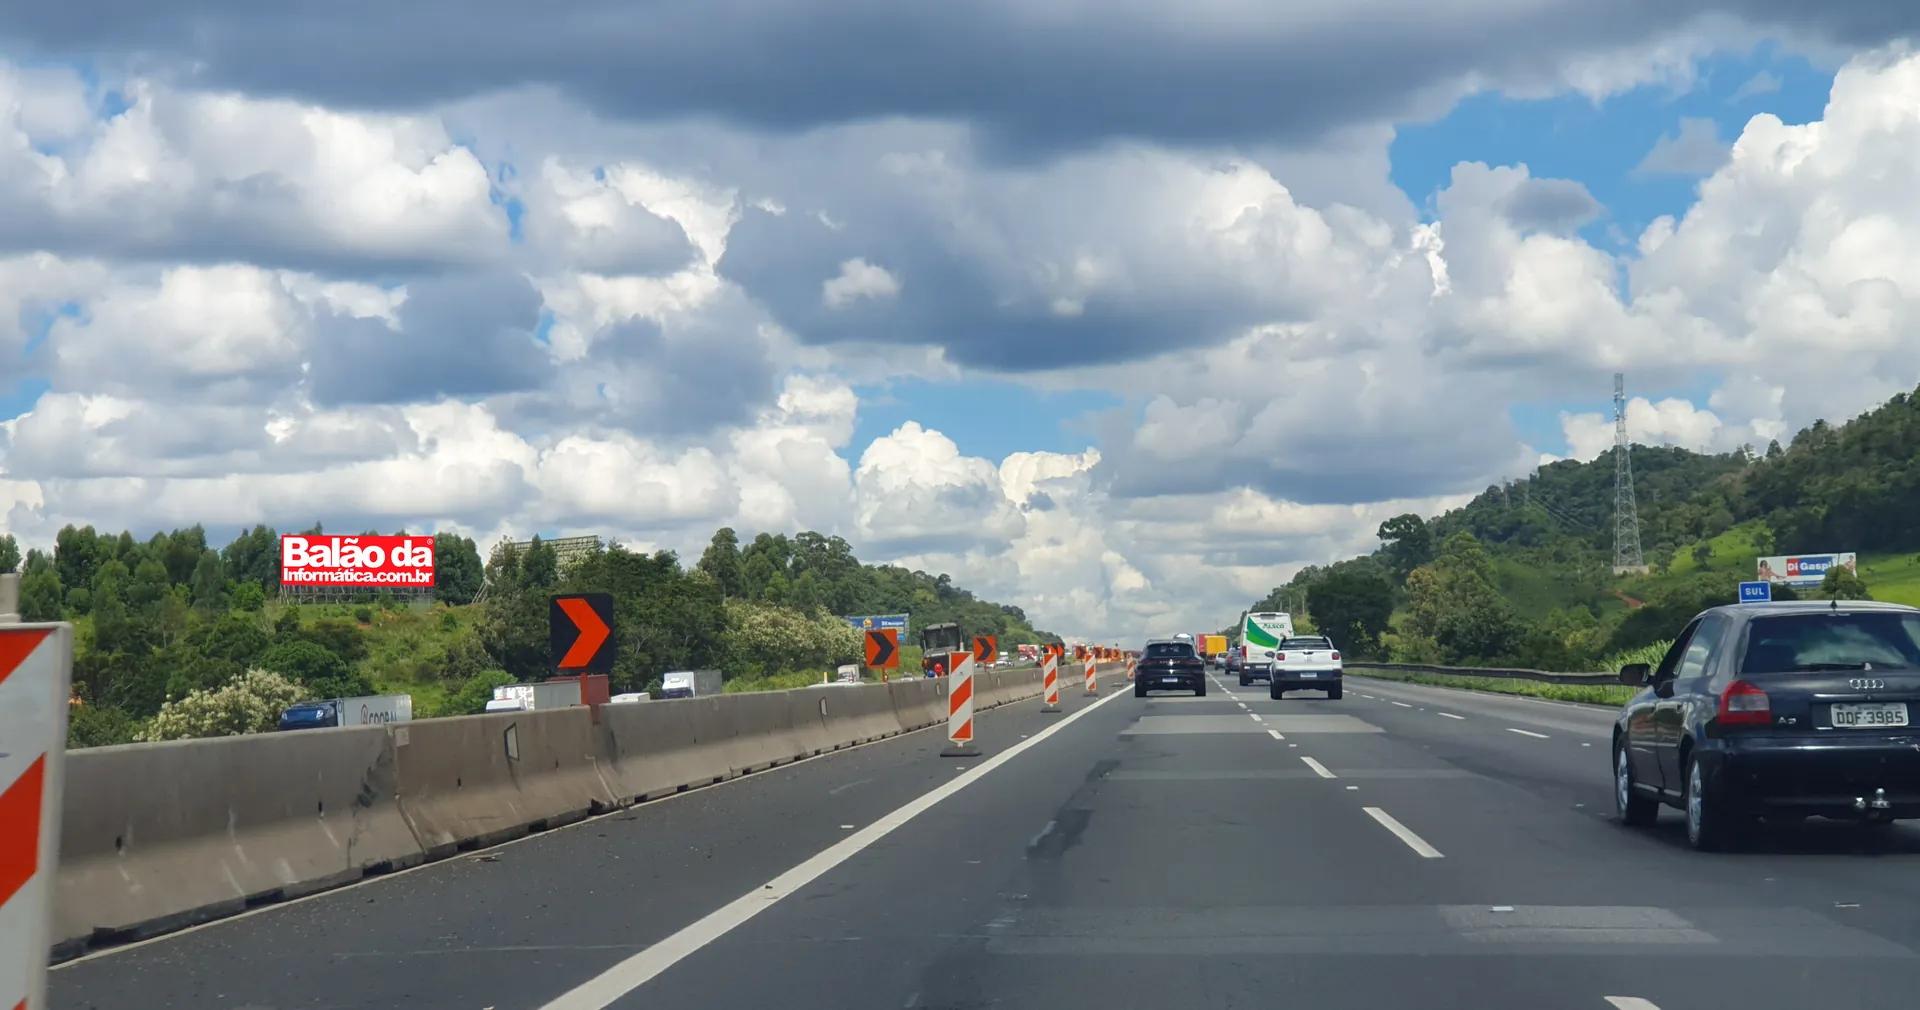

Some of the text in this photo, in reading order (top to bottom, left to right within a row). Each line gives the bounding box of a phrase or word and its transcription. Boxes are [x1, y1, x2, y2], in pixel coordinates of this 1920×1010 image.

[283, 536, 433, 568] Balão da
[283, 567, 433, 583] Informática.com.br
[1745, 587, 1765, 596] SUL
